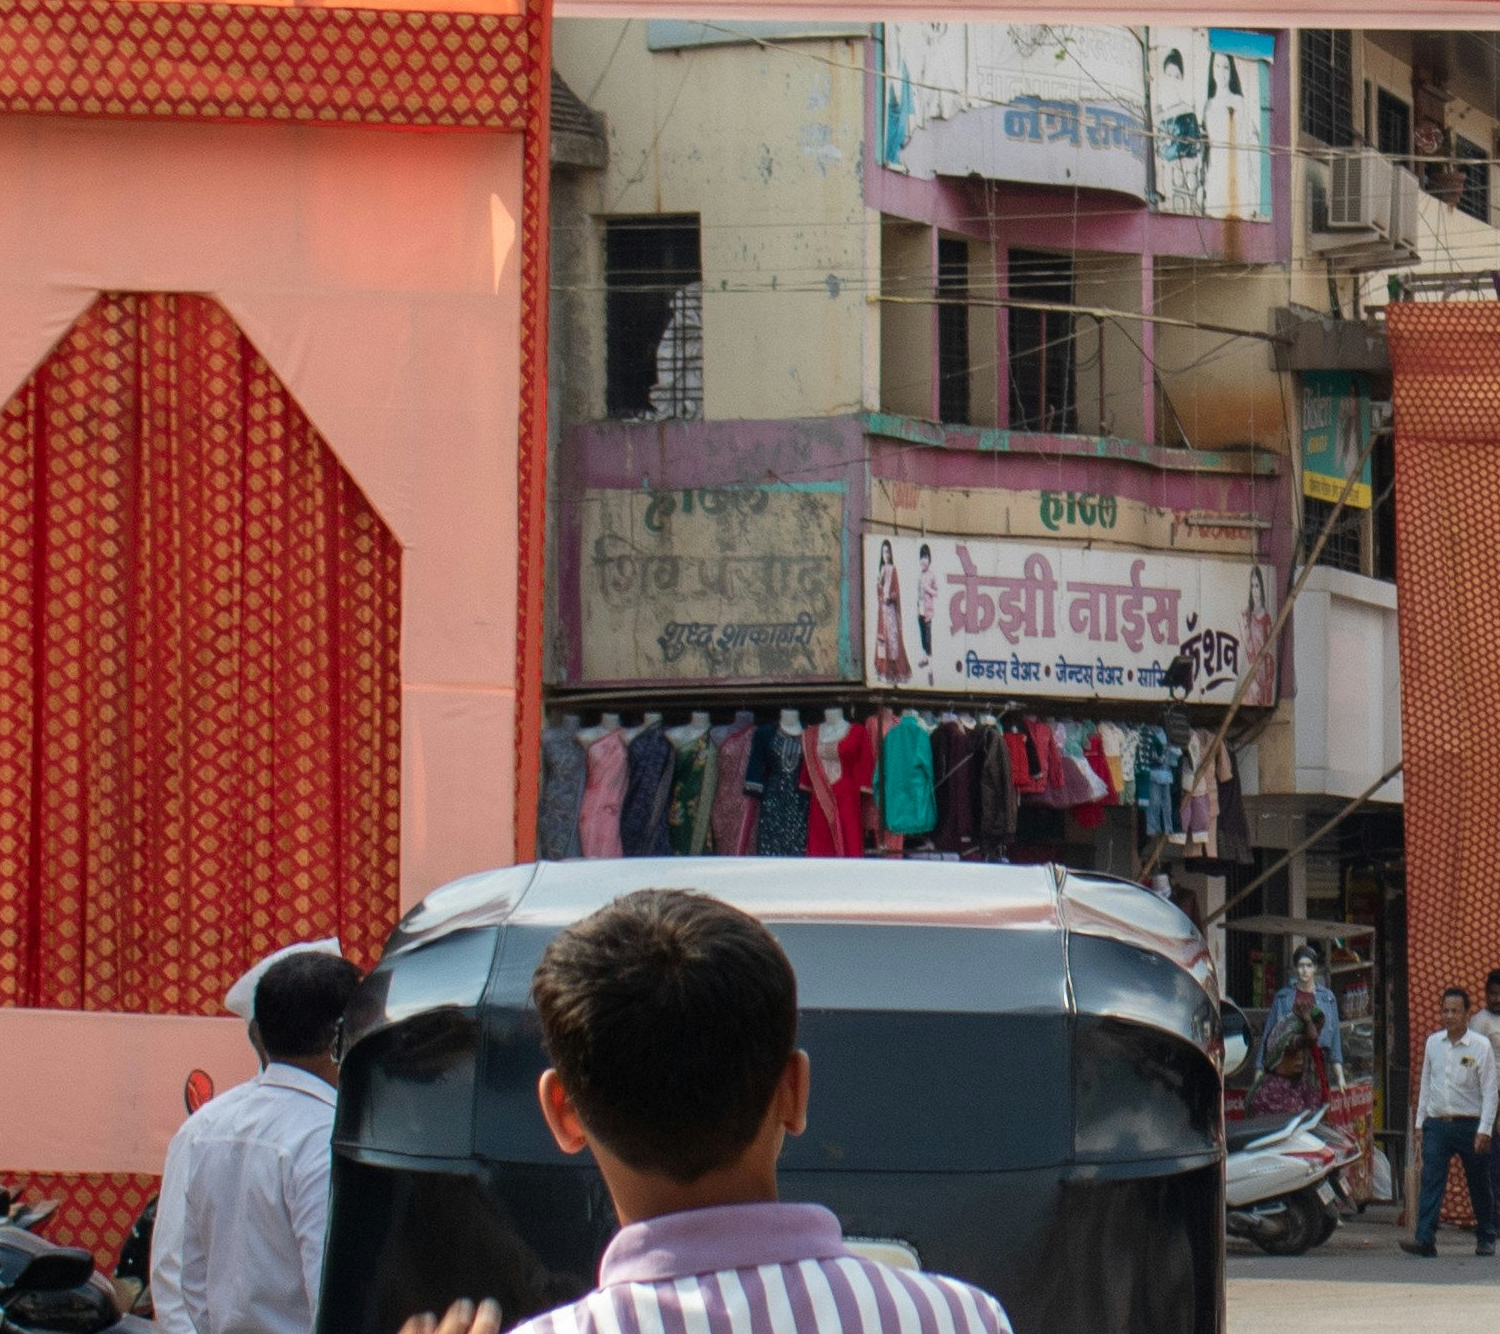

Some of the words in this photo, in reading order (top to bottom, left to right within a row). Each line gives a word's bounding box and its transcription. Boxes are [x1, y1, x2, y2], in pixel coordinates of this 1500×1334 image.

[946, 541, 1059, 646] क्रेझी
[1065, 559, 1183, 654] नाईस
[1010, 653, 1041, 683] वेअर
[1096, 657, 1125, 687] वेअर
